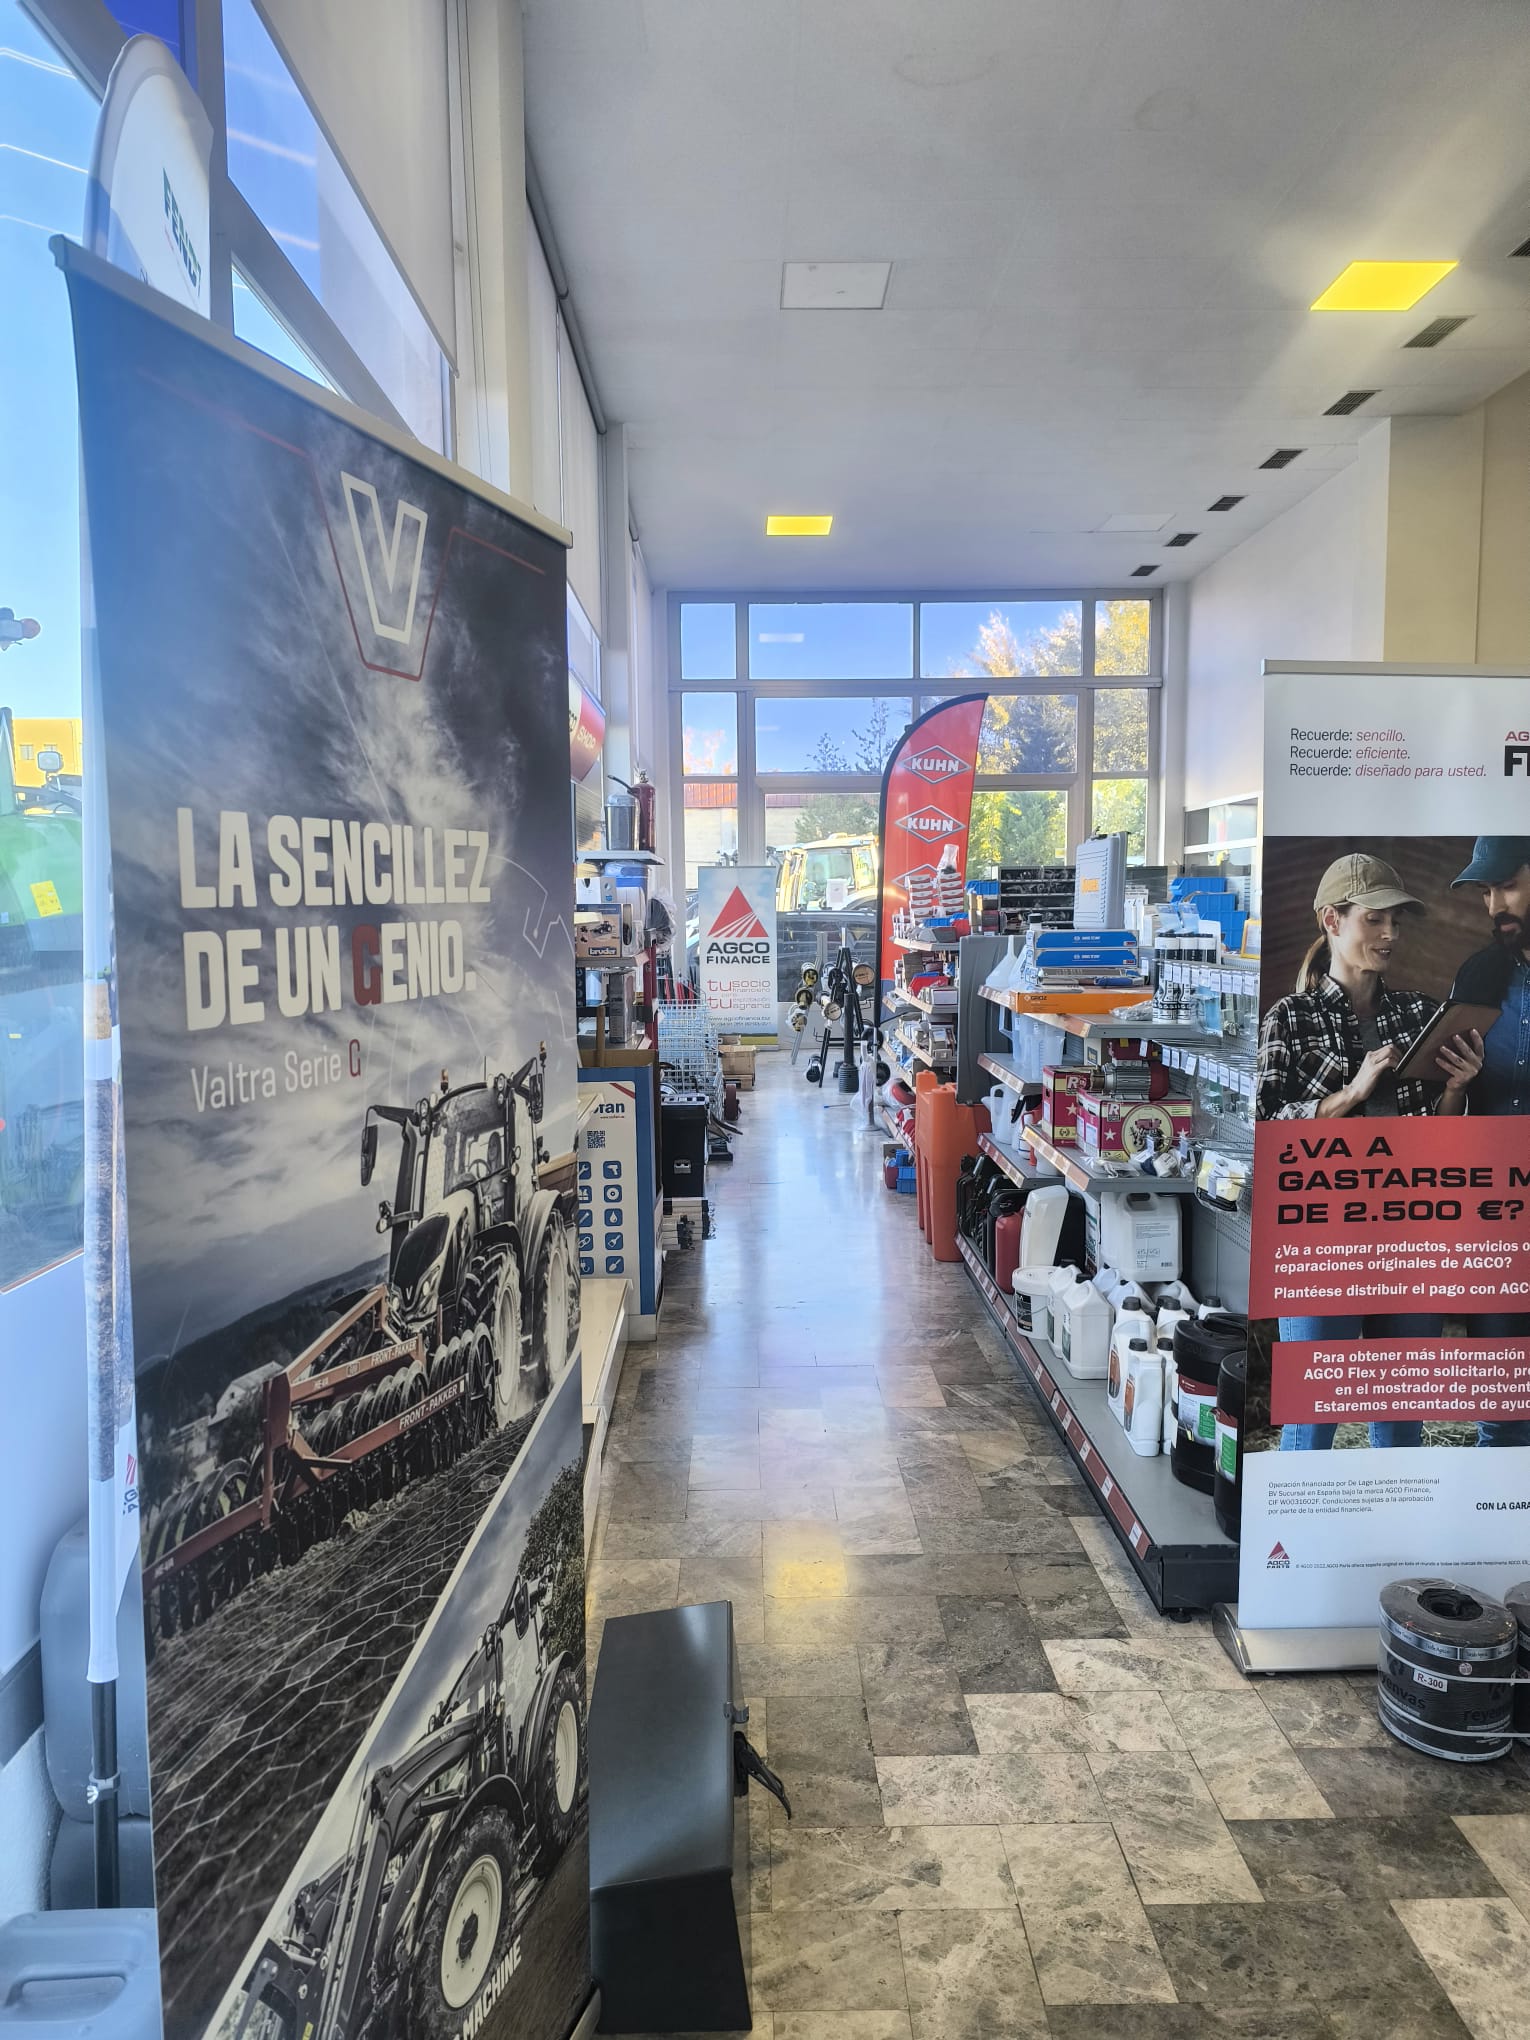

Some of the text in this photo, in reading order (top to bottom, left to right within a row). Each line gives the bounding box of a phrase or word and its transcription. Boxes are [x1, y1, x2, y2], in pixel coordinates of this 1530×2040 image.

[1290, 728, 1406, 742] Recuerde: sencillo.
[1290, 746, 1410, 760] Recuerde: eficiente.
[912, 757, 960, 772] KUHN
[1290, 764, 1487, 779] Recuerde: diseñado para usted.
[908, 817, 954, 832] KUHN
[177, 808, 491, 909] LA SENCILLEZ
[707, 942, 770, 954] AGCO
[706, 956, 770, 964] FINANCE
[183, 920, 477, 1032] DE UN GENIO.
[707, 980, 732, 992] tu
[707, 996, 732, 1009] tu
[190, 1062, 277, 1113] Valtra
[284, 1045, 342, 1093] Serie
[1279, 1136, 1393, 1164] ¿VA A
[1278, 1167, 1493, 1192] GASTARSE
[1278, 1204, 1328, 1224] DE
[1344, 1200, 1462, 1222] 2.500
[1275, 1244, 1298, 1260] ¿Va
[1303, 1246, 1312, 1256] a
[1315, 1244, 1372, 1258] comprar
[1376, 1240, 1450, 1256] productos,
[1455, 1240, 1518, 1252] servicios
[1274, 1256, 1512, 1275] reparaciones originales de AGCO?
[1274, 1286, 1342, 1299] Plantéese
[1346, 1282, 1408, 1297] distribuir
[1412, 1282, 1424, 1295] el
[1429, 1284, 1466, 1298] pago
[1470, 1285, 1496, 1295] con
[1313, 1348, 1525, 1363] Para obtener más información
[1304, 1368, 1344, 1380] AGCO
[1348, 1366, 1376, 1378] Flex
[1380, 1370, 1387, 1380] y
[1390, 1364, 1430, 1378] cómo
[1433, 1364, 1510, 1379] solicitarlo,
[1335, 1386, 1352, 1396] en
[1356, 1383, 1368, 1395] el
[1372, 1382, 1445, 1394] mostrador
[1449, 1382, 1466, 1394] de
[400, 1384, 458, 1430] FRONT-PAKKER
[1314, 1400, 1388, 1412] Estaremos
[1391, 1399, 1476, 1412] encantados
[1480, 1398, 1497, 1410] de
[1476, 1502, 1494, 1510] CON
[1496, 1502, 1507, 1510] LA
[1417, 1673, 1444, 1689] R-300
[463, 1934, 521, 2040] MACHINE
